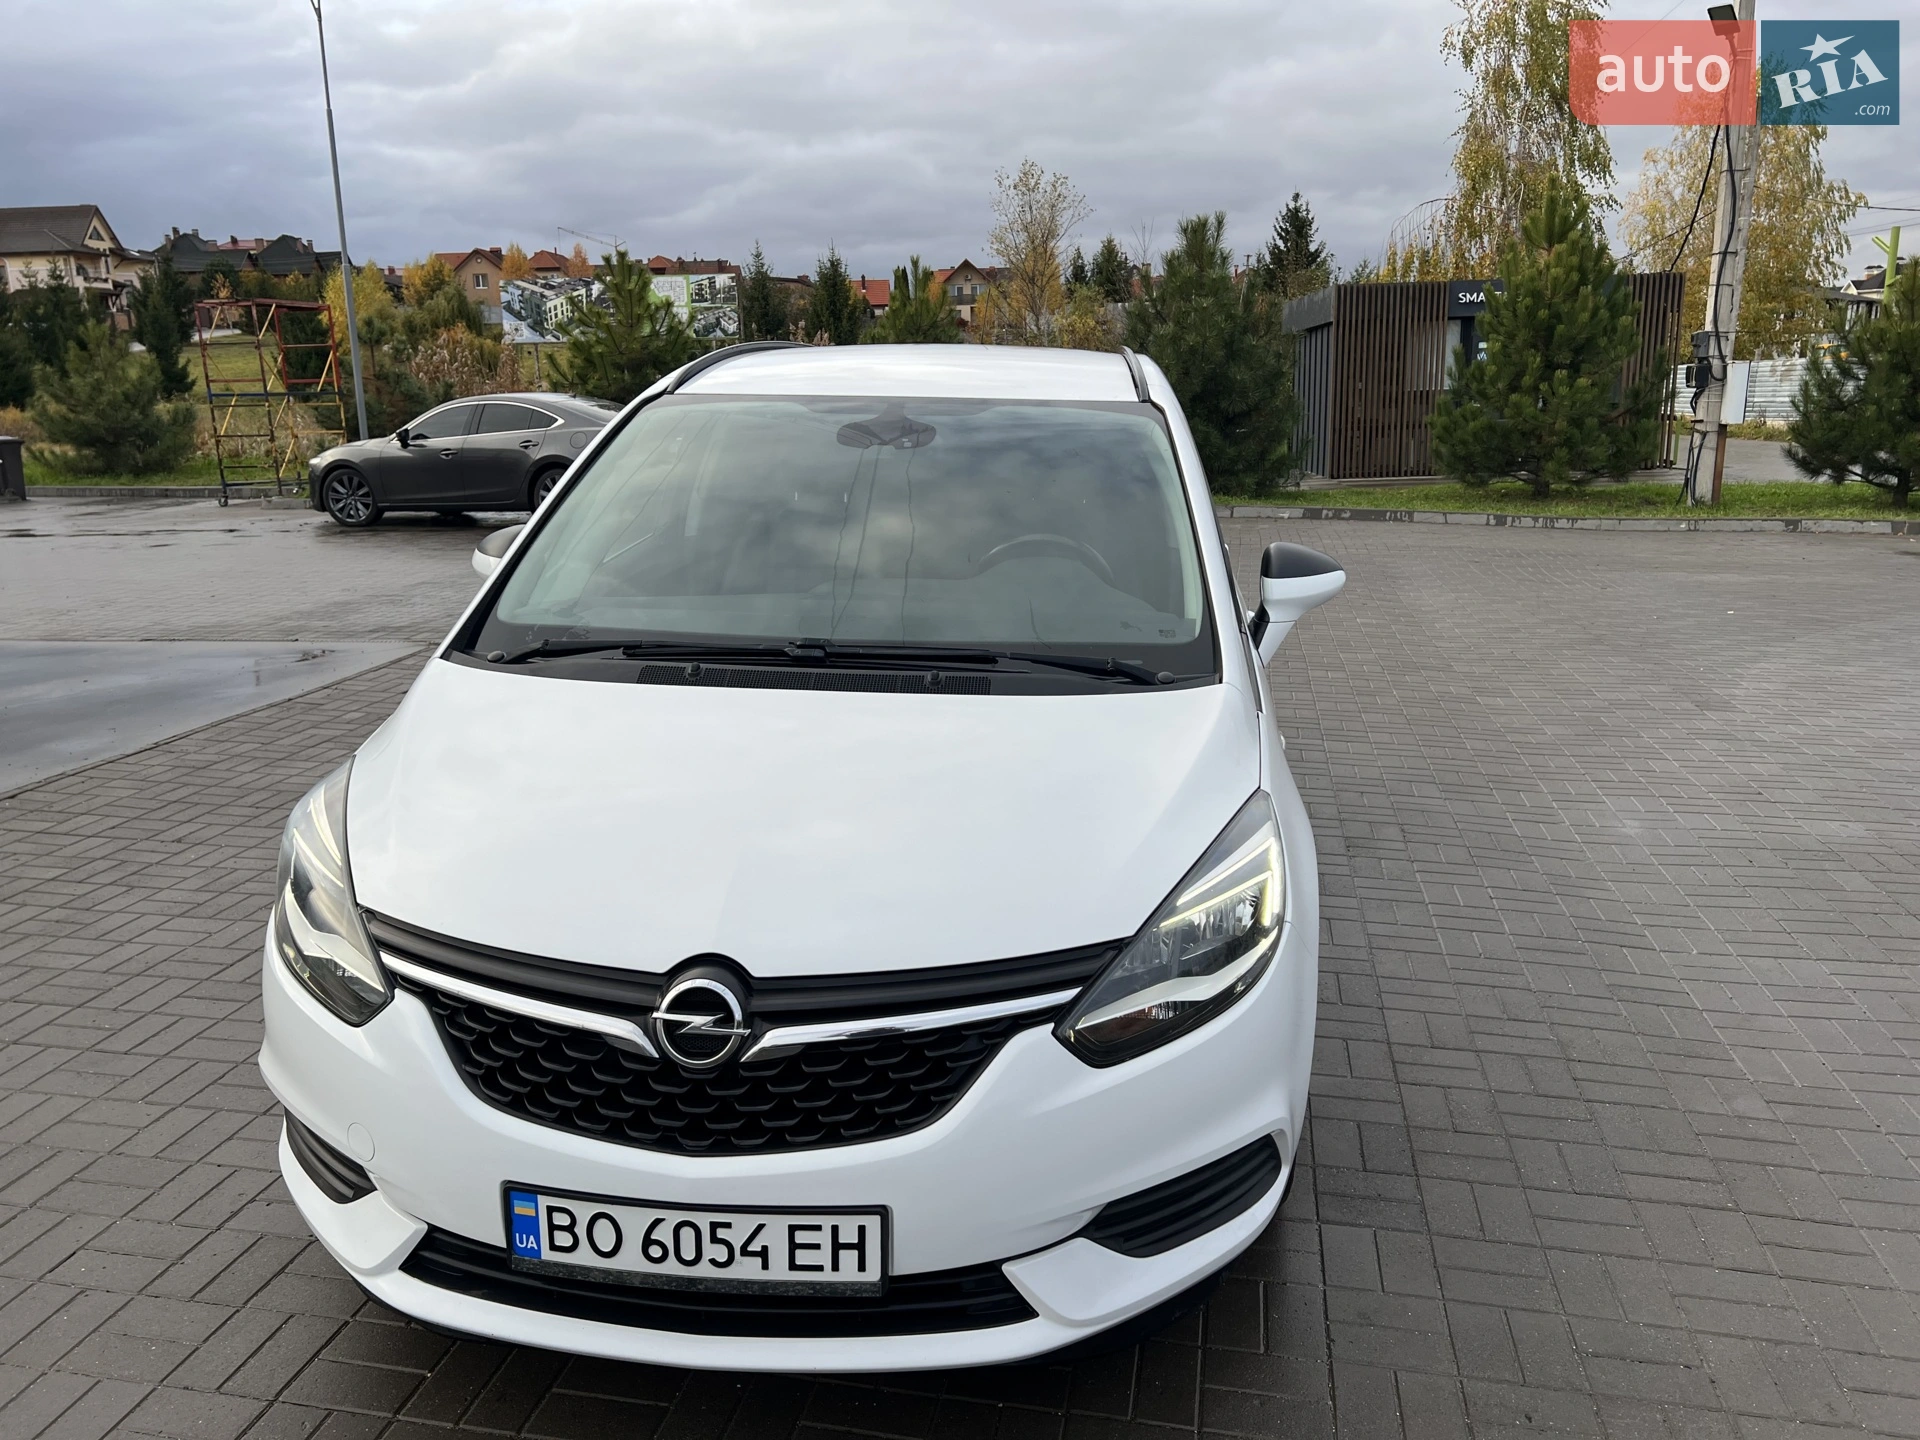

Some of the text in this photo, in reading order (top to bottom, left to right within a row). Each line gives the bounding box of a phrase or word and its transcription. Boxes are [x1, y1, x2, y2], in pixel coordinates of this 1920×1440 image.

[515, 1232, 538, 1251] UA
[545, 1203, 867, 1273] BO 6054 EH
